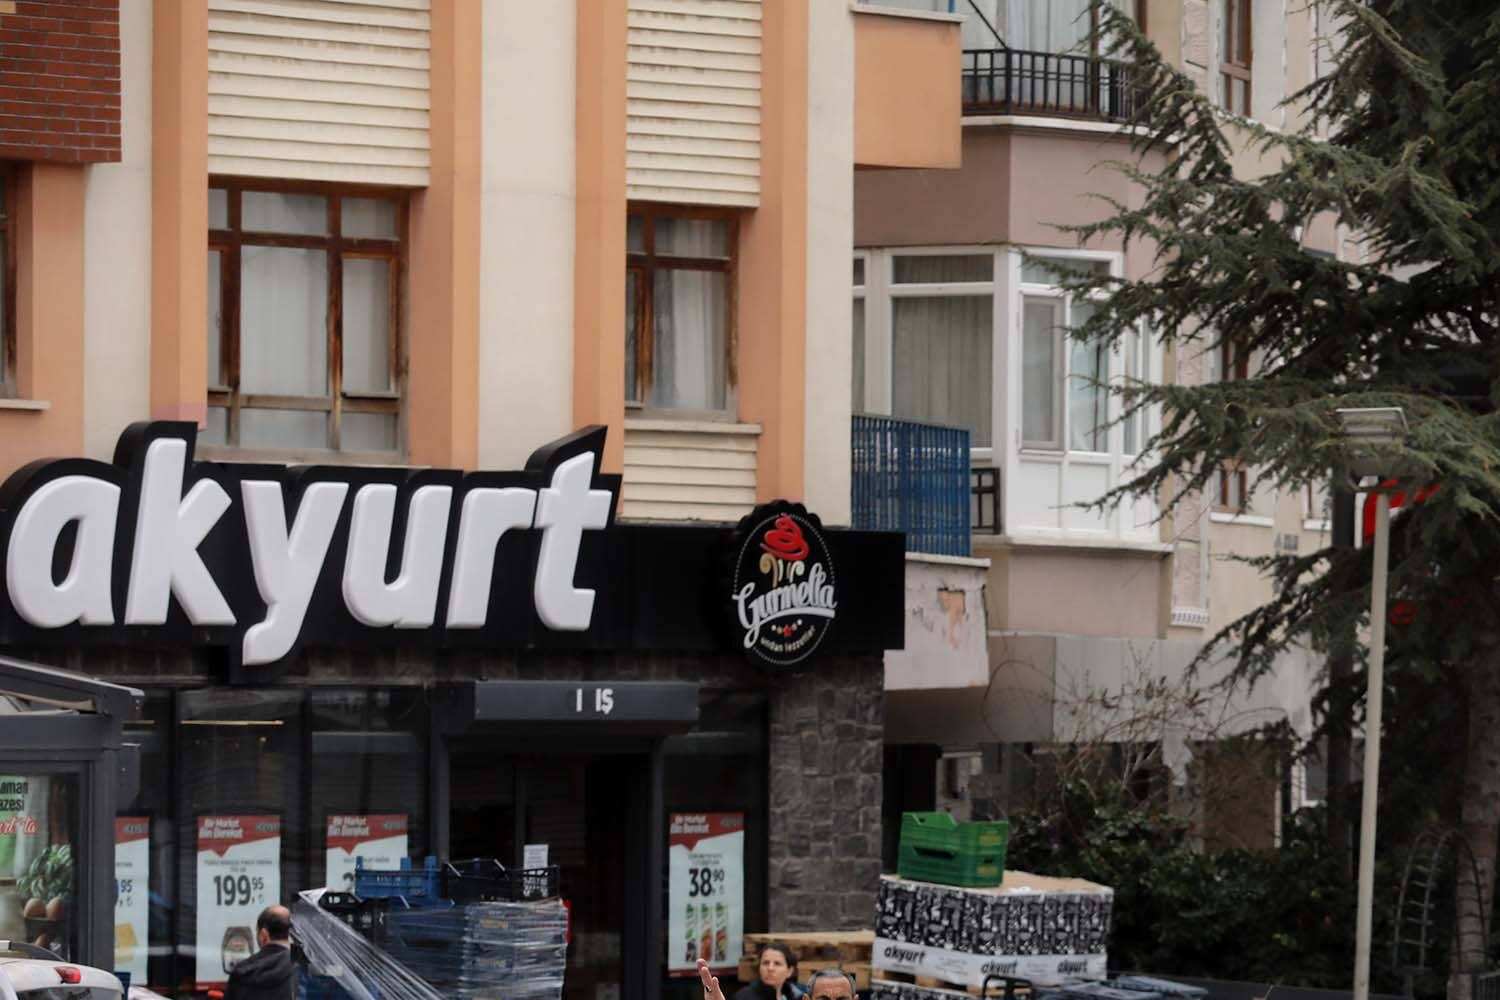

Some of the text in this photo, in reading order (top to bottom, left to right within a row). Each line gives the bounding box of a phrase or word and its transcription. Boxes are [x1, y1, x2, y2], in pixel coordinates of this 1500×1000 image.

[6, 437, 612, 666] akyurt
[213, 875, 251, 906] 199
[689, 868, 711, 897] 38
[884, 946, 927, 965] akyurt
[981, 958, 1019, 976] akyurt
[1057, 959, 1088, 975] akyurt
